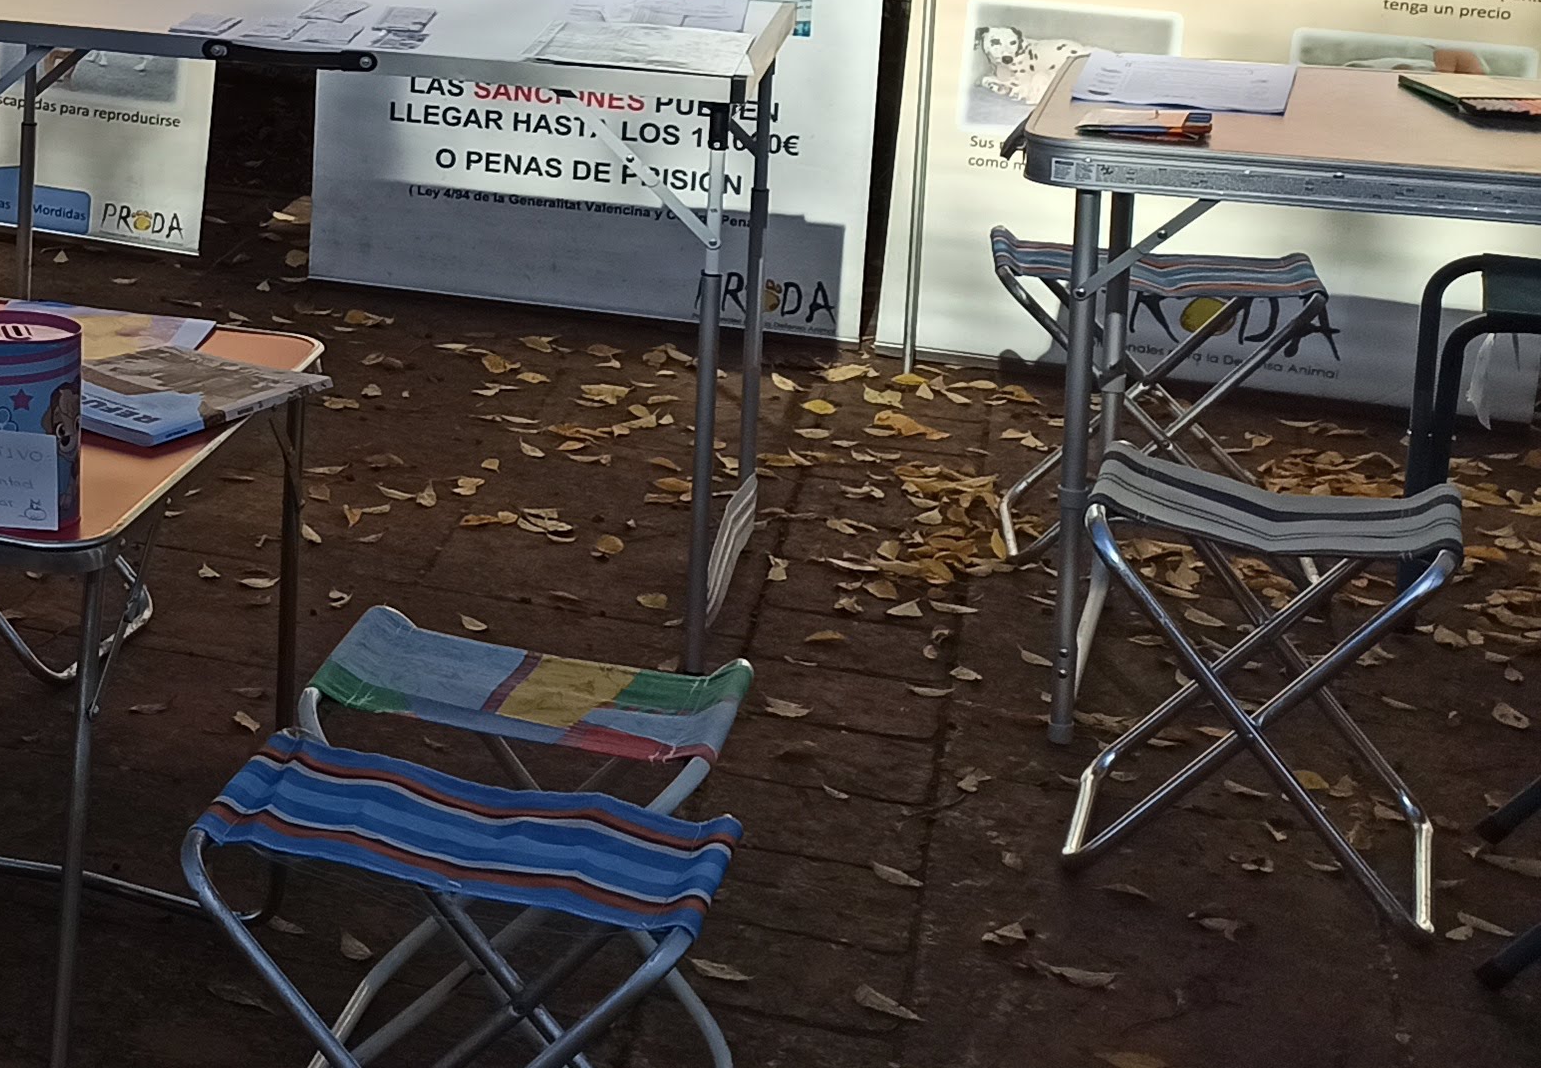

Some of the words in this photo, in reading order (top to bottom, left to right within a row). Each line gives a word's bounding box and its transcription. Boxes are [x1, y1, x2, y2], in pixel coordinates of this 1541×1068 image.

[1432, 4, 1454, 16] un
[1457, 6, 1512, 21] precio
[409, 78, 465, 98] LAS
[58, 103, 90, 117] para
[92, 107, 181, 128] reproducirse
[388, 100, 503, 131] LLEGAR
[619, 120, 681, 146] LOS
[434, 147, 457, 169] O
[464, 149, 563, 179] PENAS
[571, 158, 612, 184] DE
[967, 153, 1010, 169] como
